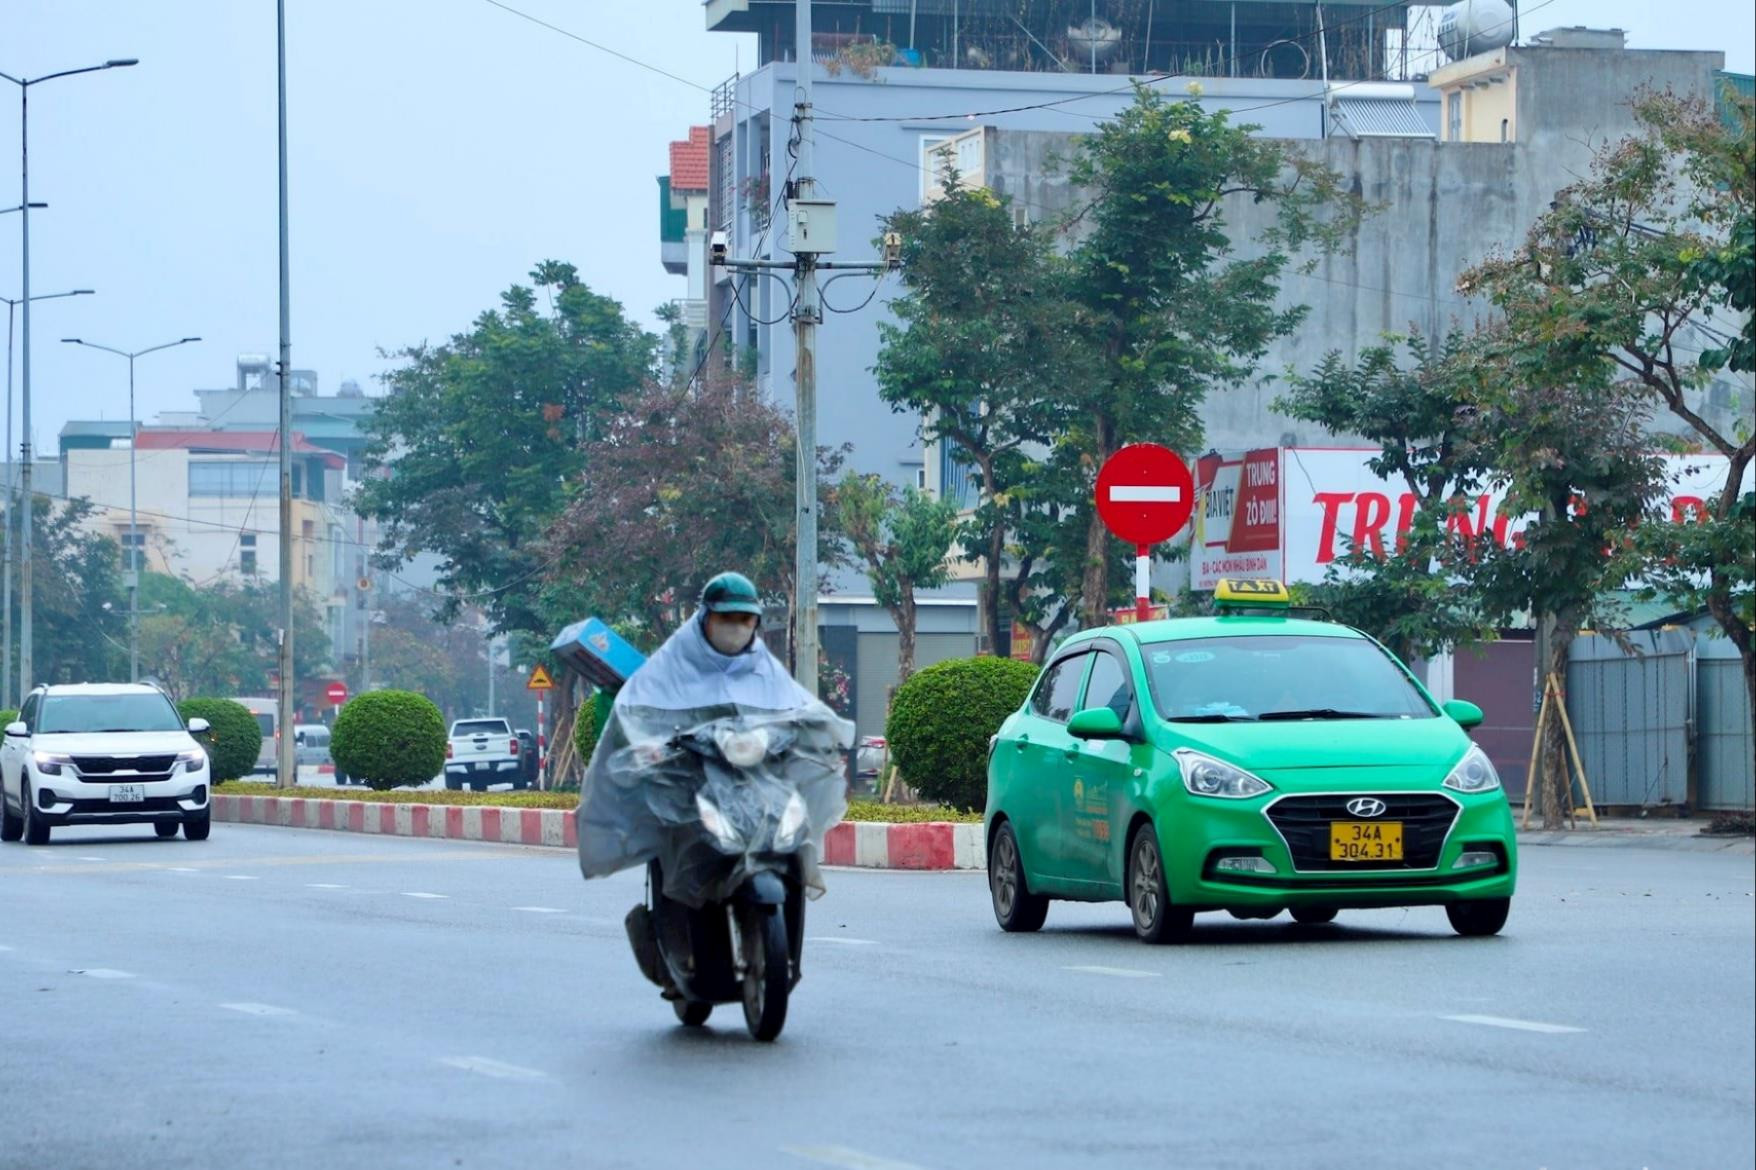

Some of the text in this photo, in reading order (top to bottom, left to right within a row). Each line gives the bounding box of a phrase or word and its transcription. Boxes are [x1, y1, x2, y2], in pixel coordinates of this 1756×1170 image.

[1247, 461, 1275, 487] TRUNG
[1228, 580, 1277, 593] TAXI
[1352, 825, 1382, 841] 34A
[1339, 843, 1393, 858] 304.31
